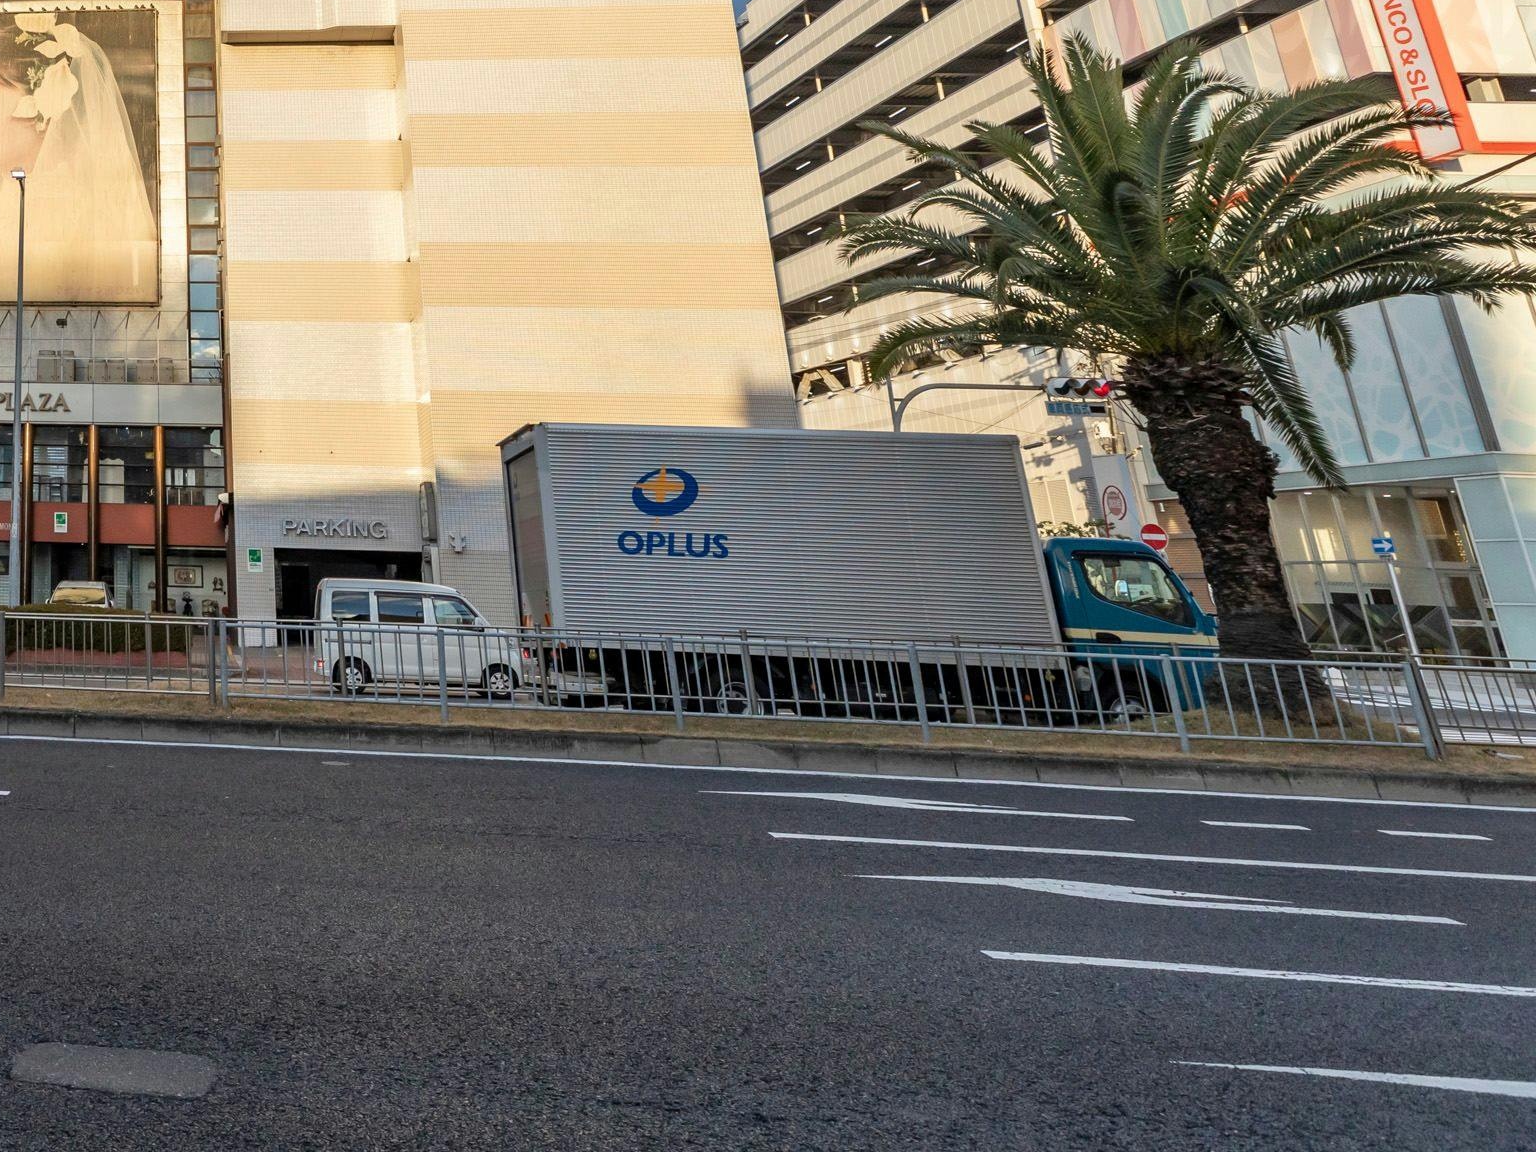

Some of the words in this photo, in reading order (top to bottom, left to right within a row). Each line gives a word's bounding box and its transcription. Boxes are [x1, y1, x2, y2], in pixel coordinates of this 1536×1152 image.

[1399, 48, 1419, 66] &
[1406, 69, 1446, 131] SLO
[282, 519, 389, 539] PARKING
[617, 530, 729, 558] OPLUS
